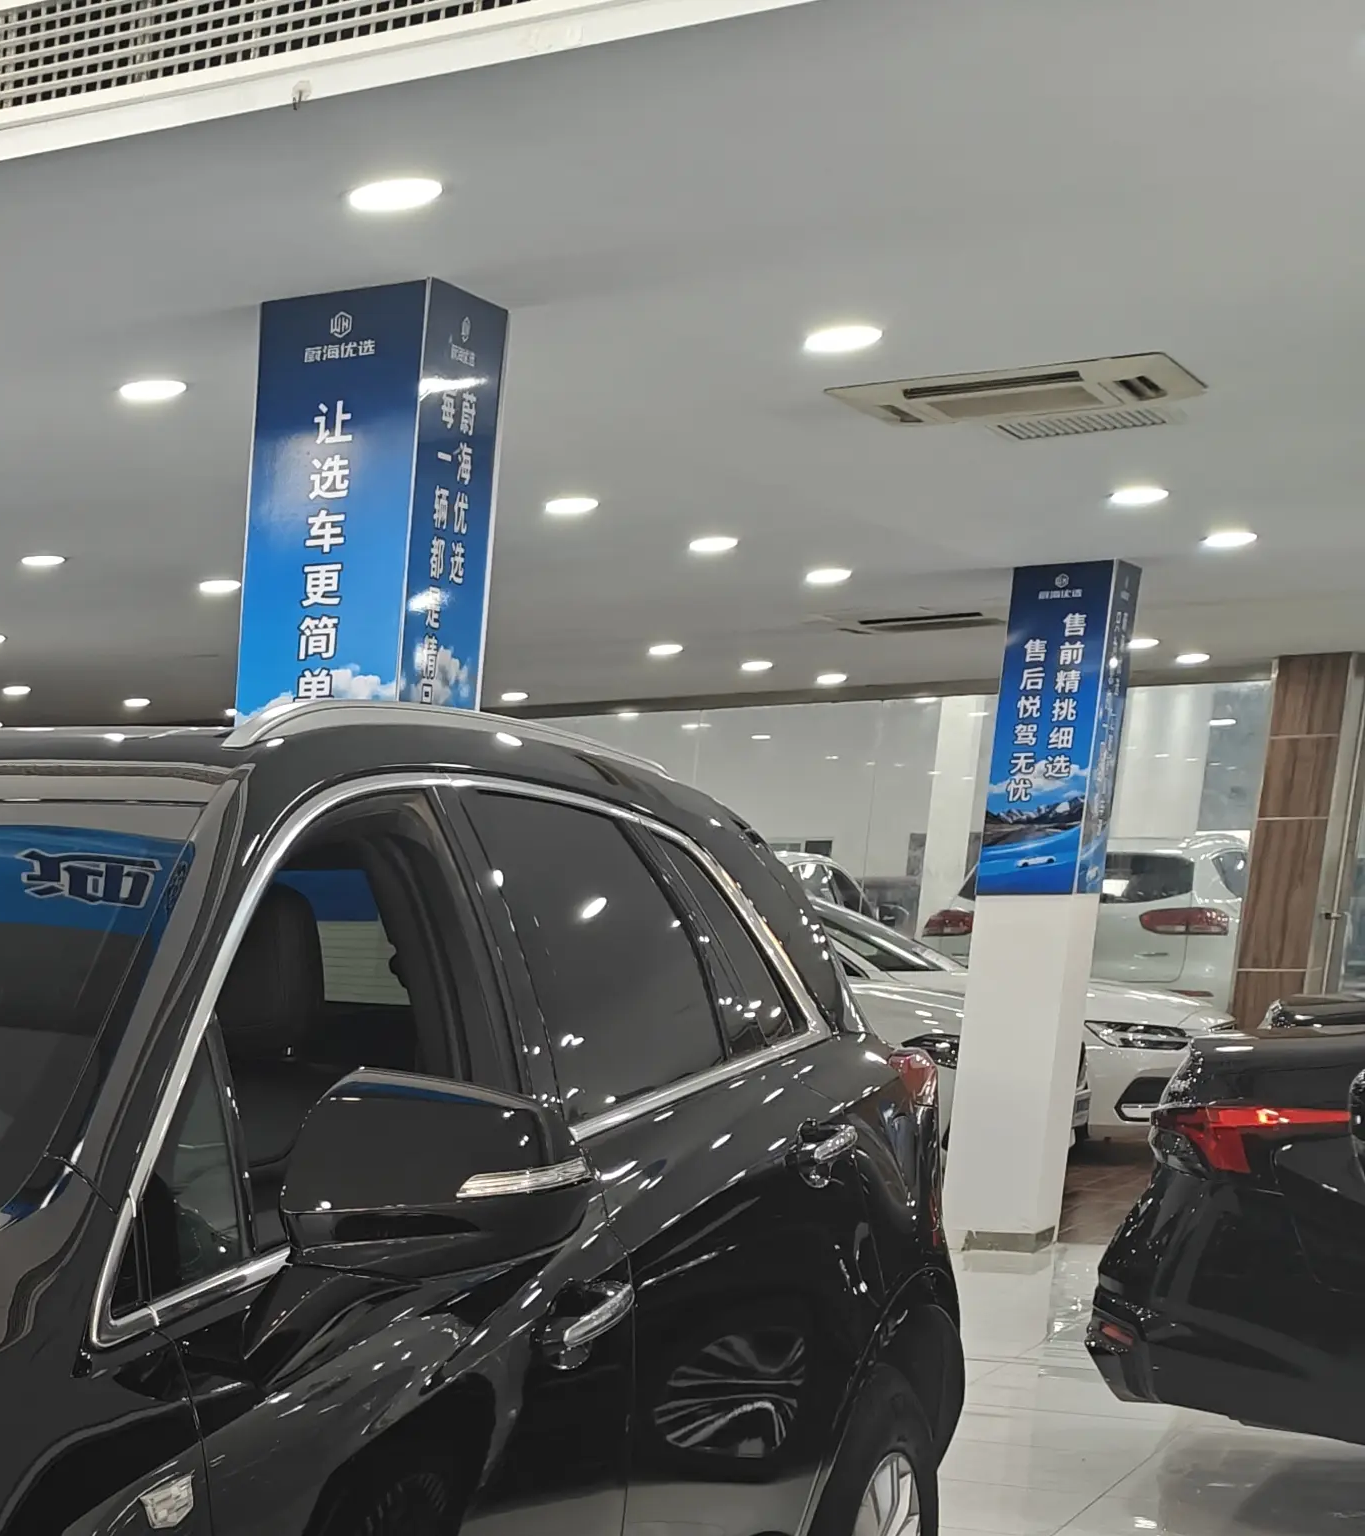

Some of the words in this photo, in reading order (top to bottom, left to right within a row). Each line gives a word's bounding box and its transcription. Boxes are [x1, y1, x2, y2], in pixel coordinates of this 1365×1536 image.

[304, 340, 375, 363] 蔚海优选
[294, 400, 354, 703] 让选车更简单
[449, 391, 477, 585] 蔚海优选
[1005, 638, 1047, 803] 售后悦驾无忧
[1044, 612, 1087, 779] 售前精挑细选
